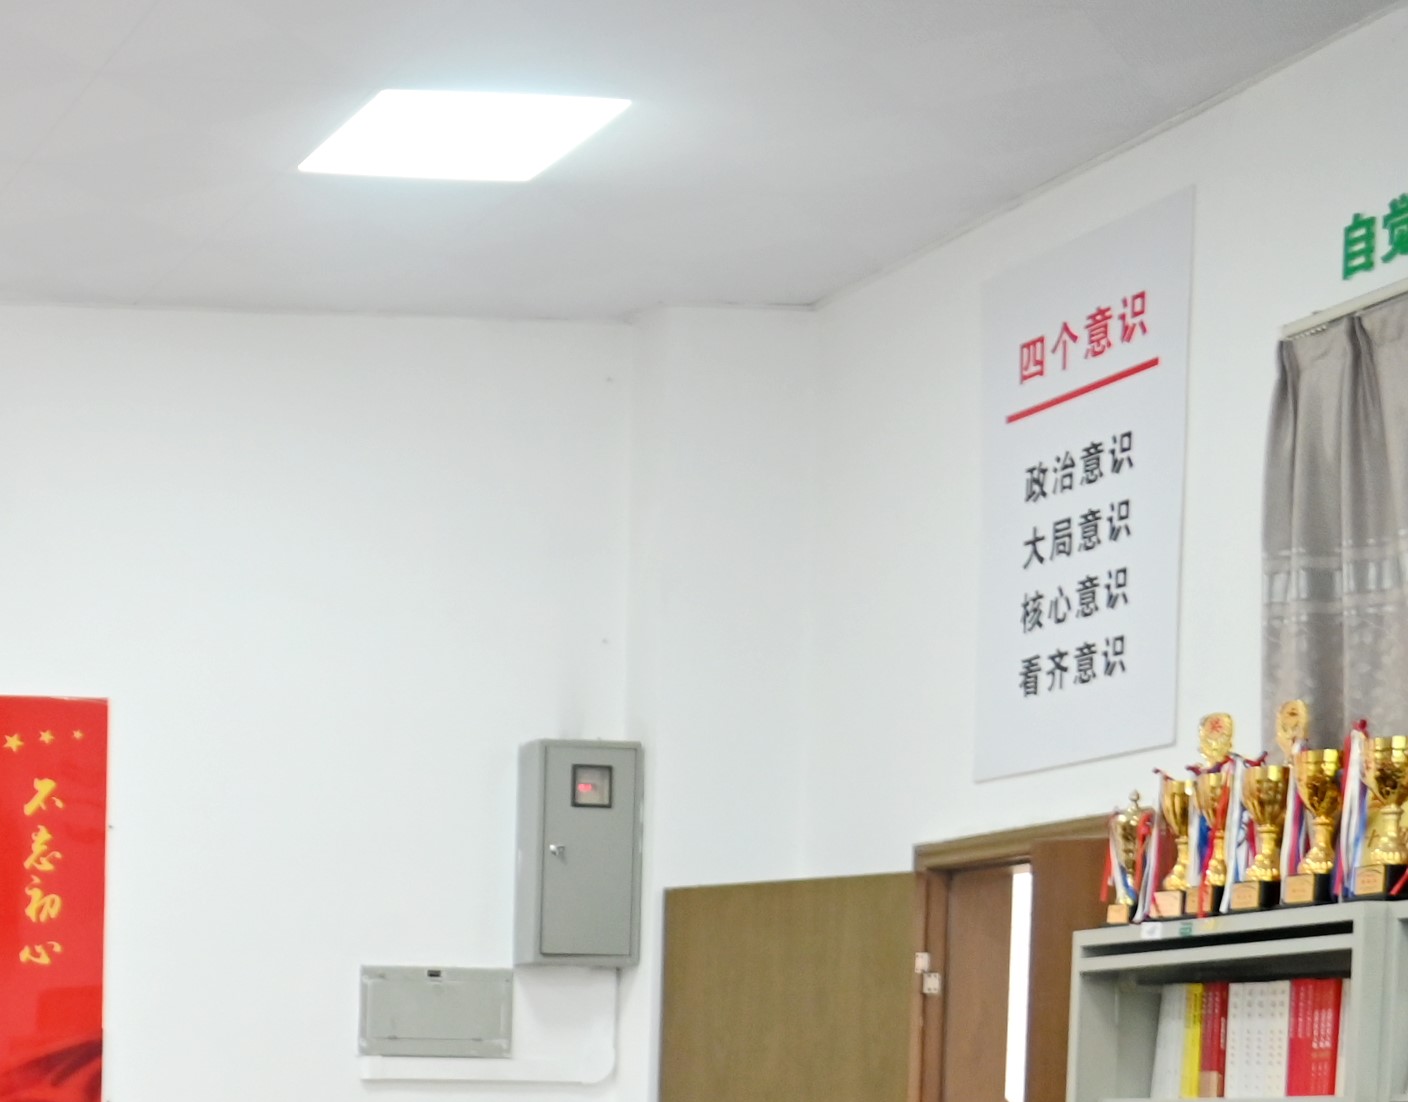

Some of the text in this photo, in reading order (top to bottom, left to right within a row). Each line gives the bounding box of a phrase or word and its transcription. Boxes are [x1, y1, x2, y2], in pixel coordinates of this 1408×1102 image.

[1342, 192, 1408, 281] 自觉
[1018, 290, 1151, 386] 四个意识
[1024, 430, 1135, 503] 政治意识
[1022, 499, 1132, 570] 大局意识
[1019, 566, 1130, 634] 核心意识
[1018, 634, 1128, 698] 看齐意识
[18, 777, 64, 966] 不忘初心
